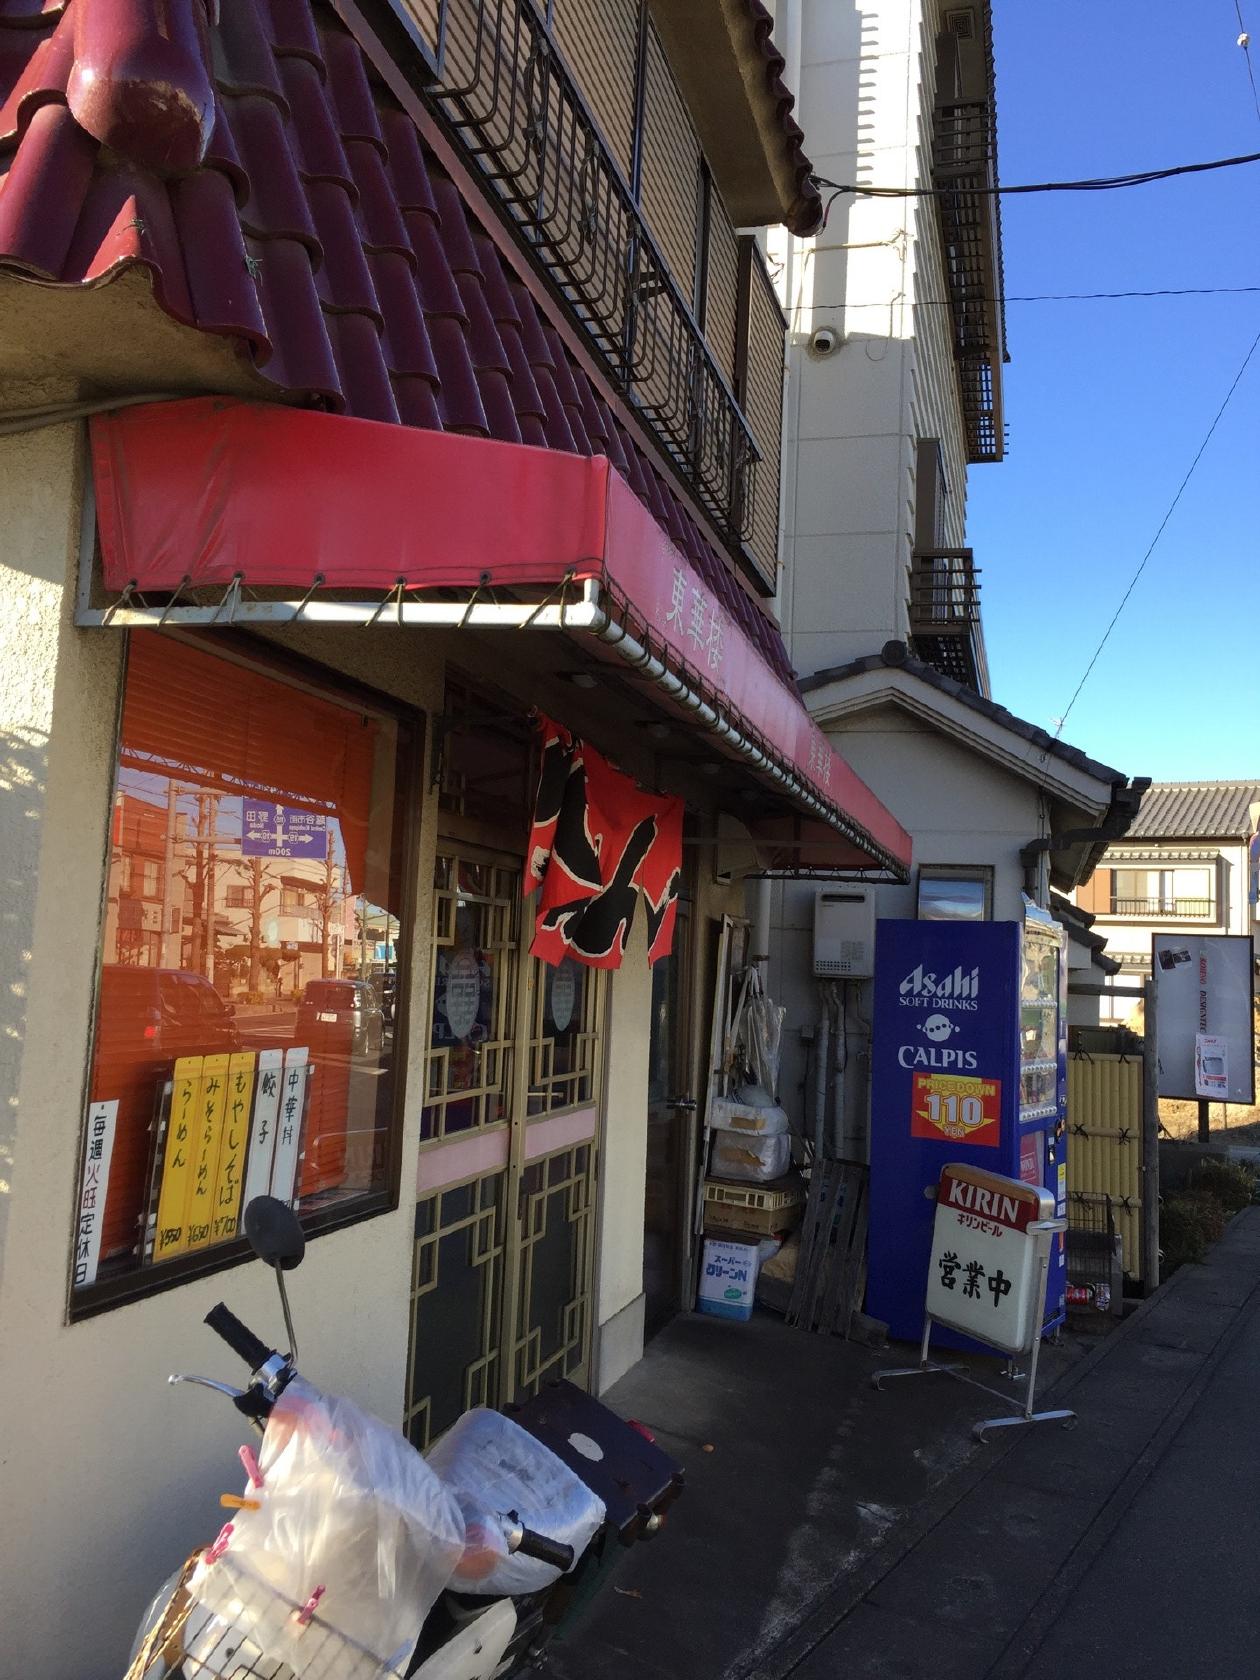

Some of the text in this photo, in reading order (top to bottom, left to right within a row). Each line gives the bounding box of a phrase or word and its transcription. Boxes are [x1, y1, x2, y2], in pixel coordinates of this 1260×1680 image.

[900, 964, 980, 999] Asahi
[899, 997, 978, 1011] SOFT DRINKS
[898, 1045, 978, 1069] CALPIS
[172, 1080, 193, 1169] らーめん
[258, 1072, 276, 1145] 餃子
[924, 1093, 984, 1127] 110
[195, 1077, 221, 1196] みそらーめん
[948, 1179, 1020, 1223] KIRIN
[957, 1213, 1003, 1238] キリンビール
[714, 1255, 741, 1266] スーパー
[939, 1251, 1012, 1308] 営業中
